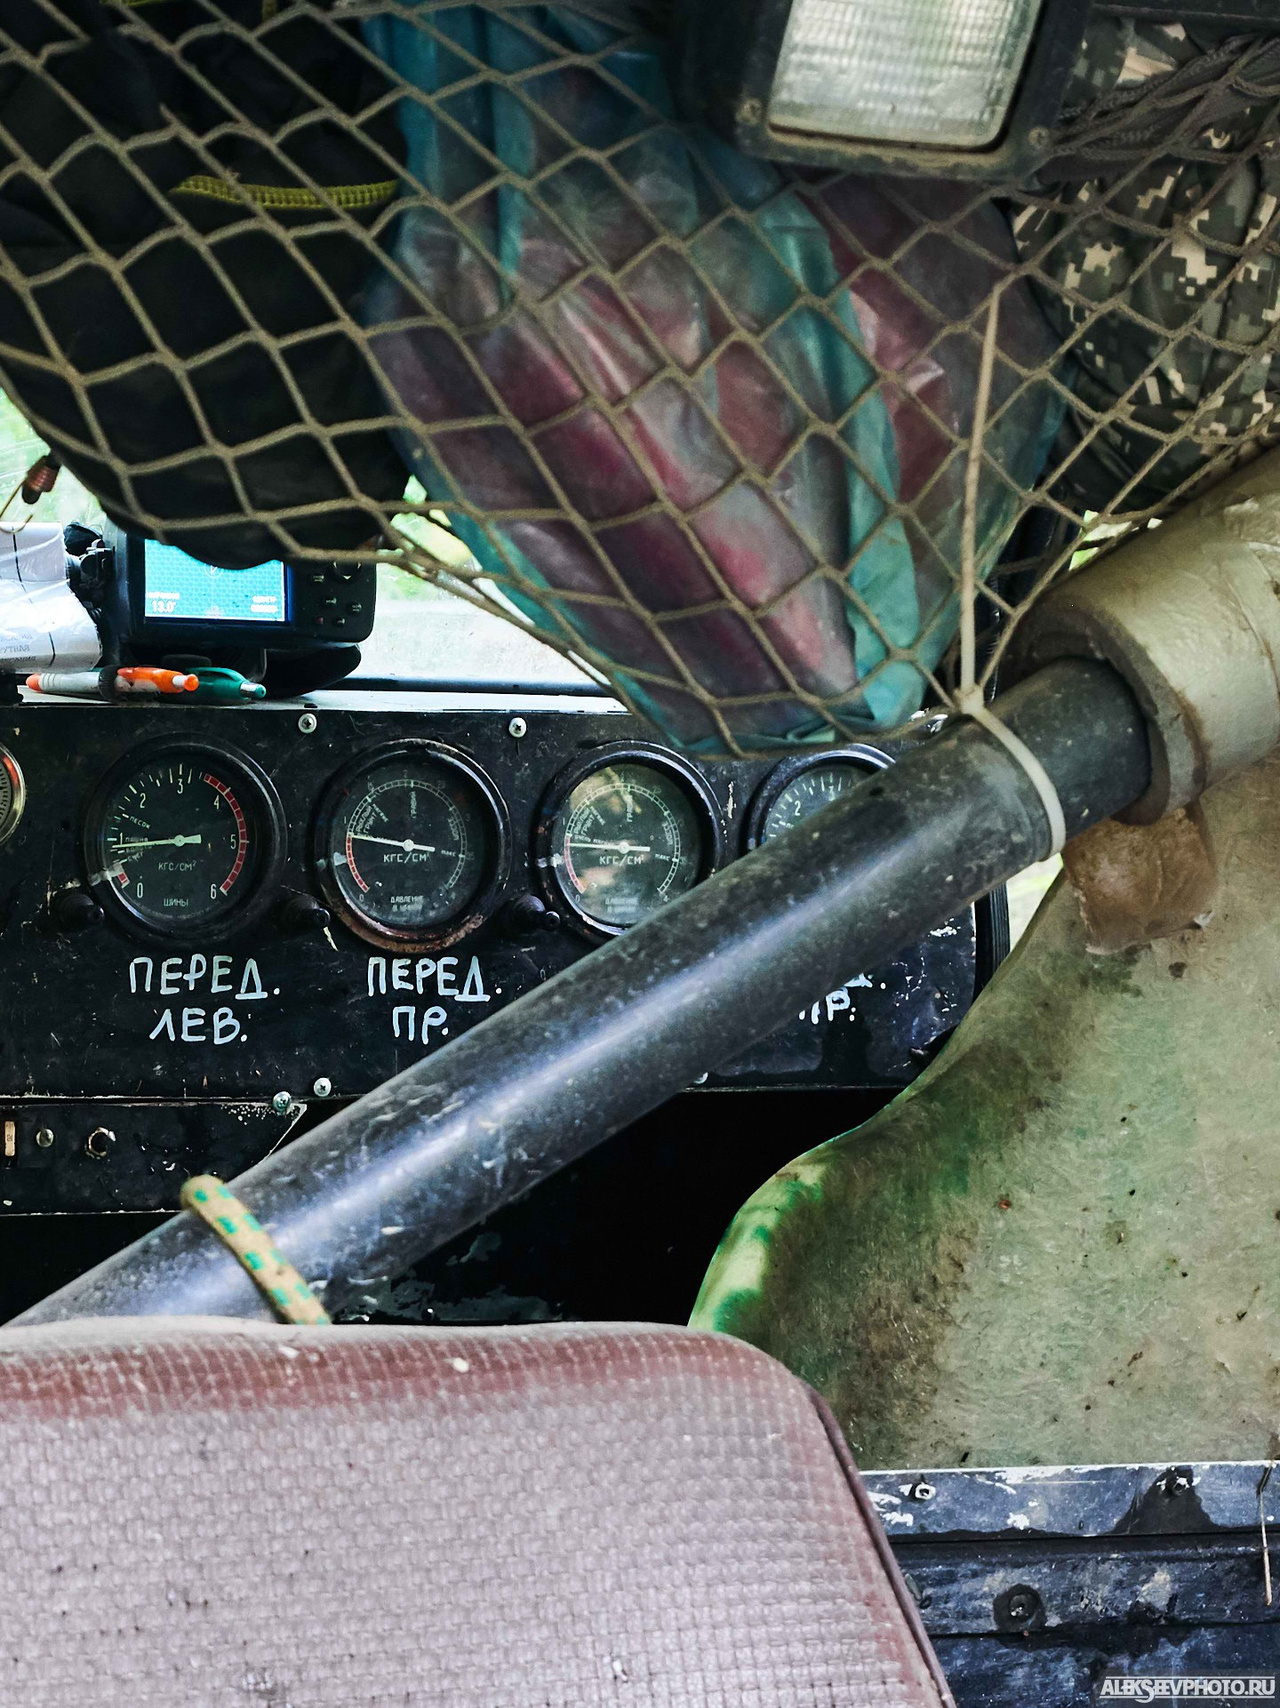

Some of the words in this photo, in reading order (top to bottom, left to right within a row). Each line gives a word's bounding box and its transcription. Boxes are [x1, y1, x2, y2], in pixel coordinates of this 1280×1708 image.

[177, 778, 184, 795] 3
[139, 792, 146, 809] 2
[213, 794, 221, 810] 4
[794, 800, 801, 816] 2
[229, 833, 236, 850] 5
[136, 882, 144, 899] 0
[210, 883, 217, 899] 6
[163, 897, 189, 907] ШИНЫ
[129, 953, 280, 1000] ПЕРЕД.
[367, 955, 503, 1002] ПЕРЕД.
[149, 1006, 248, 1045] ЛЕВ.
[392, 1005, 449, 1045] ПР.
